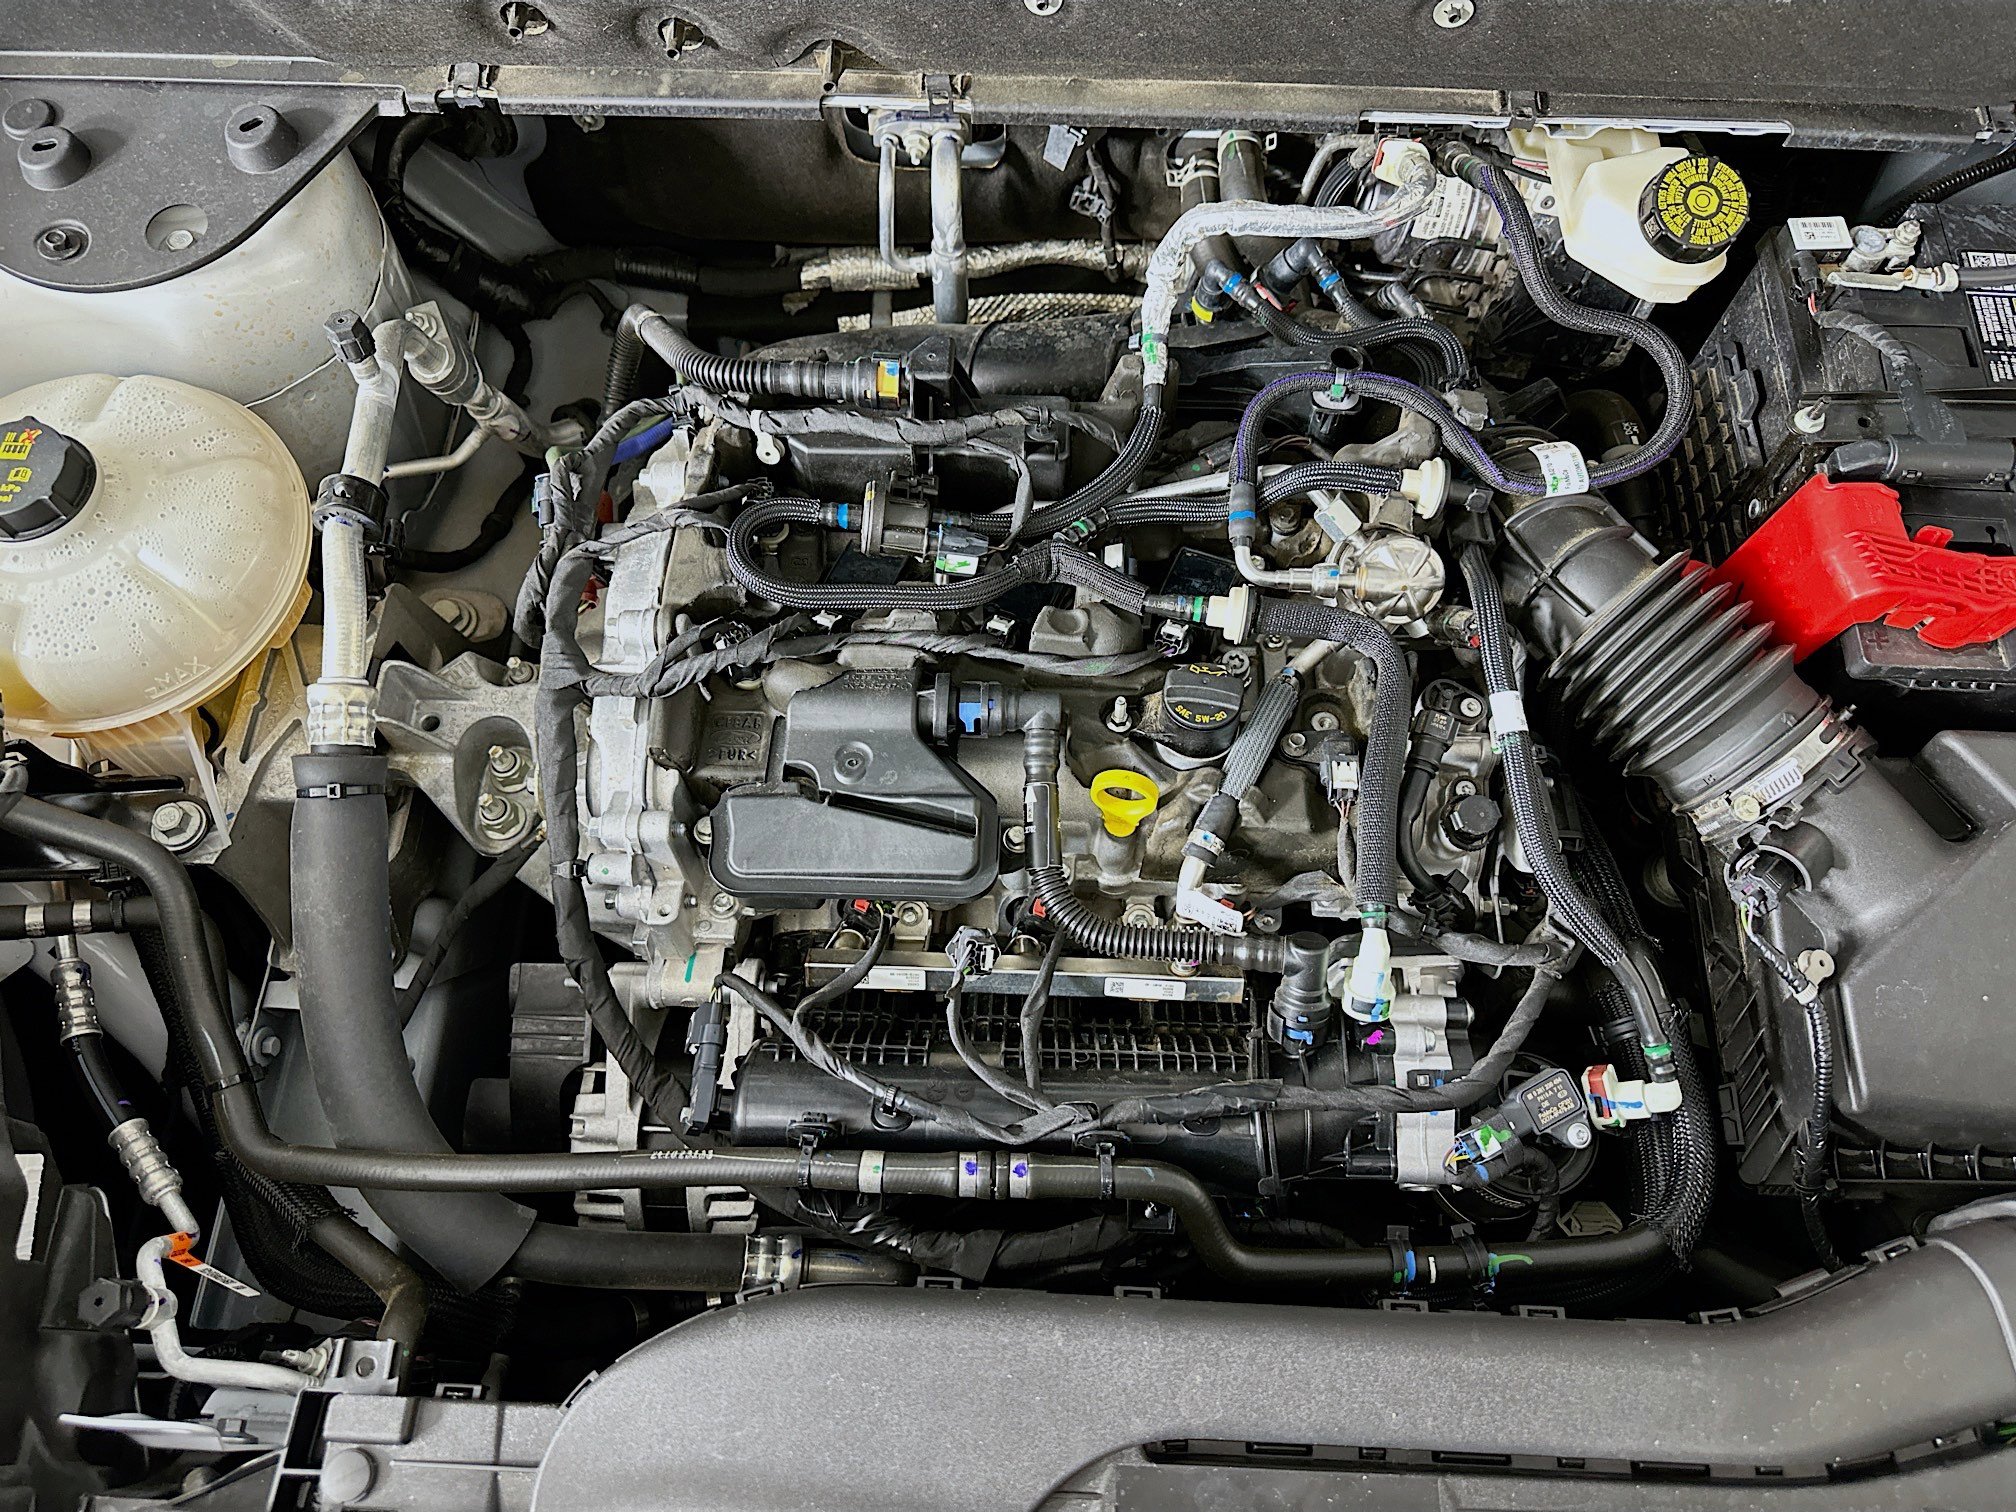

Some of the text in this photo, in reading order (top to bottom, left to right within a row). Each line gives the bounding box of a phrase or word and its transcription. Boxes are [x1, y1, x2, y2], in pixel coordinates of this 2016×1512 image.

[154, 656, 205, 691] MAX
[1175, 705, 1227, 723] SAE 5W-20
